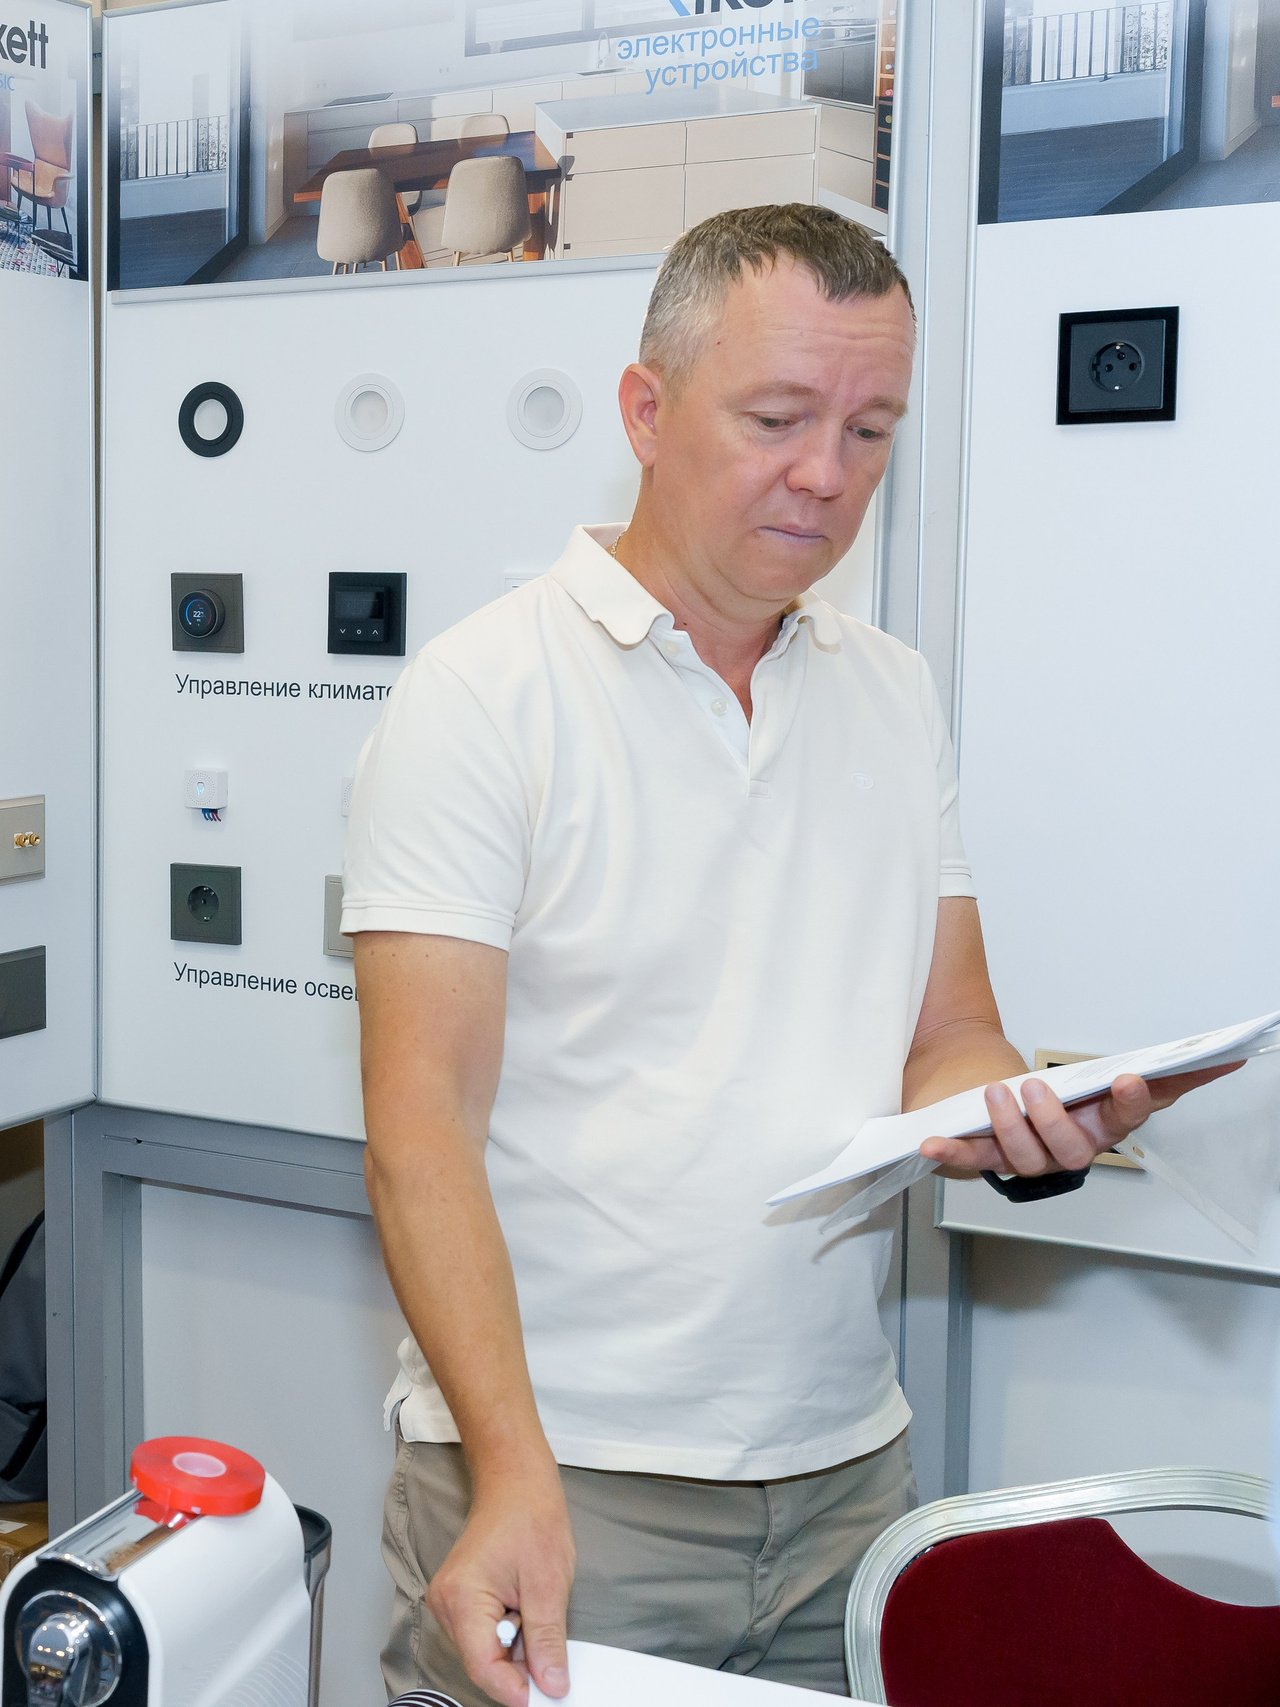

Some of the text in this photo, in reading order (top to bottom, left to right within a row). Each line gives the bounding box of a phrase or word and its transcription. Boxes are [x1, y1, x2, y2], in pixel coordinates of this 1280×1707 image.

[617, 16, 820, 60] электронные
[645, 50, 818, 95] устройства
[175, 674, 301, 699] Управление
[173, 961, 359, 1002] Управление осве
